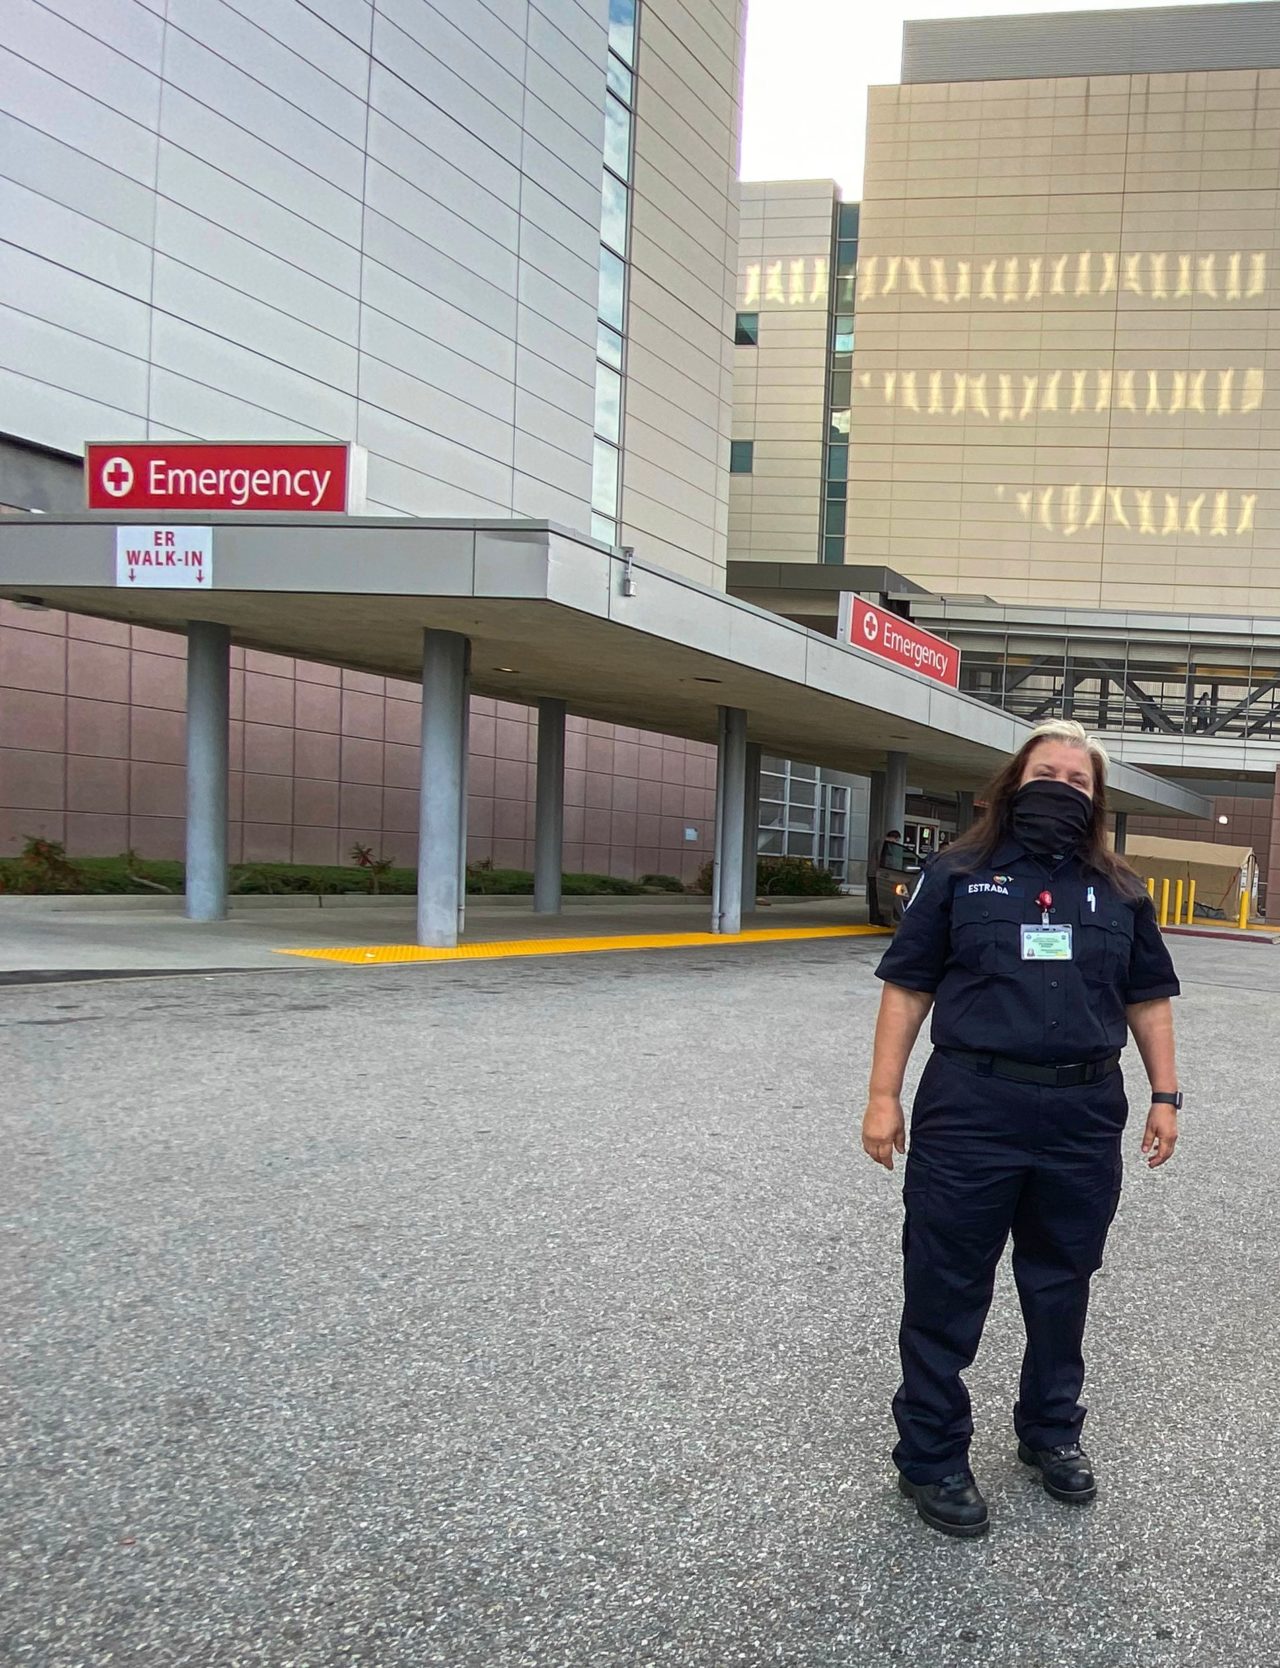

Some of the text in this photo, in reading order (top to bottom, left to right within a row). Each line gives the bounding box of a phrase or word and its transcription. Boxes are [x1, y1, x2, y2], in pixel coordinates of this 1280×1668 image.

[149, 459, 332, 506] Emergency
[154, 531, 176, 546] ER
[126, 551, 203, 566] WALK-IN
[883, 622, 948, 677] Emergency
[968, 883, 1009, 895] ESTRADA
